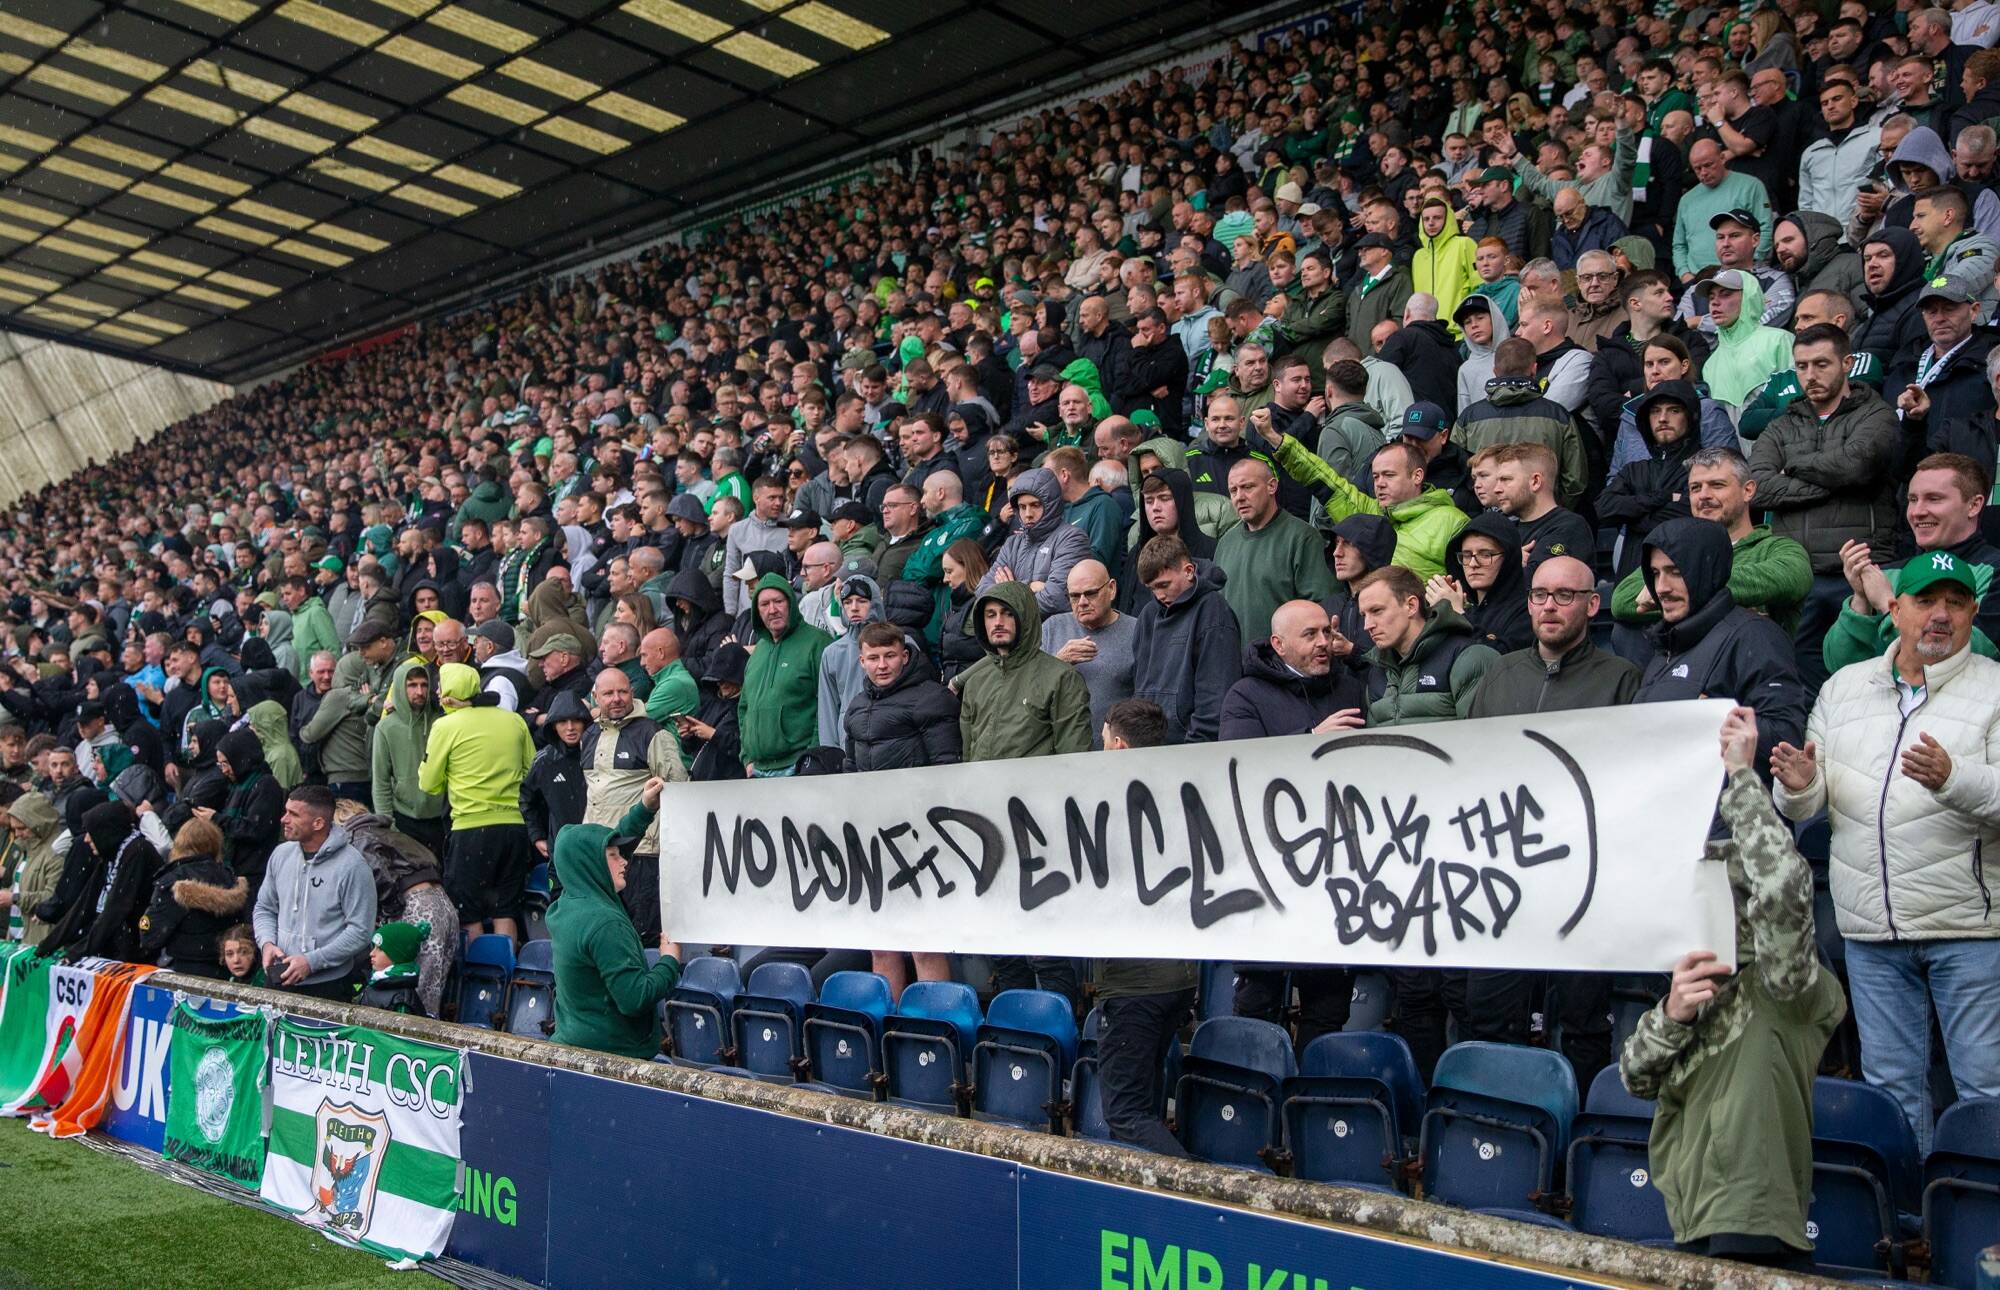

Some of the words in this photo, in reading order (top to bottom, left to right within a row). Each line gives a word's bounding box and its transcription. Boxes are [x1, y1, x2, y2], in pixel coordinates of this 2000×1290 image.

[1931, 553, 1954, 571] NY
[702, 810, 778, 898] NO
[1448, 784, 1571, 868] THE
[56, 975, 87, 1007] CSC
[275, 1029, 375, 1096] LEITH
[385, 1053, 454, 1119] CSC
[334, 1122, 364, 1140] LEITH
[459, 1166, 517, 1227] ING
